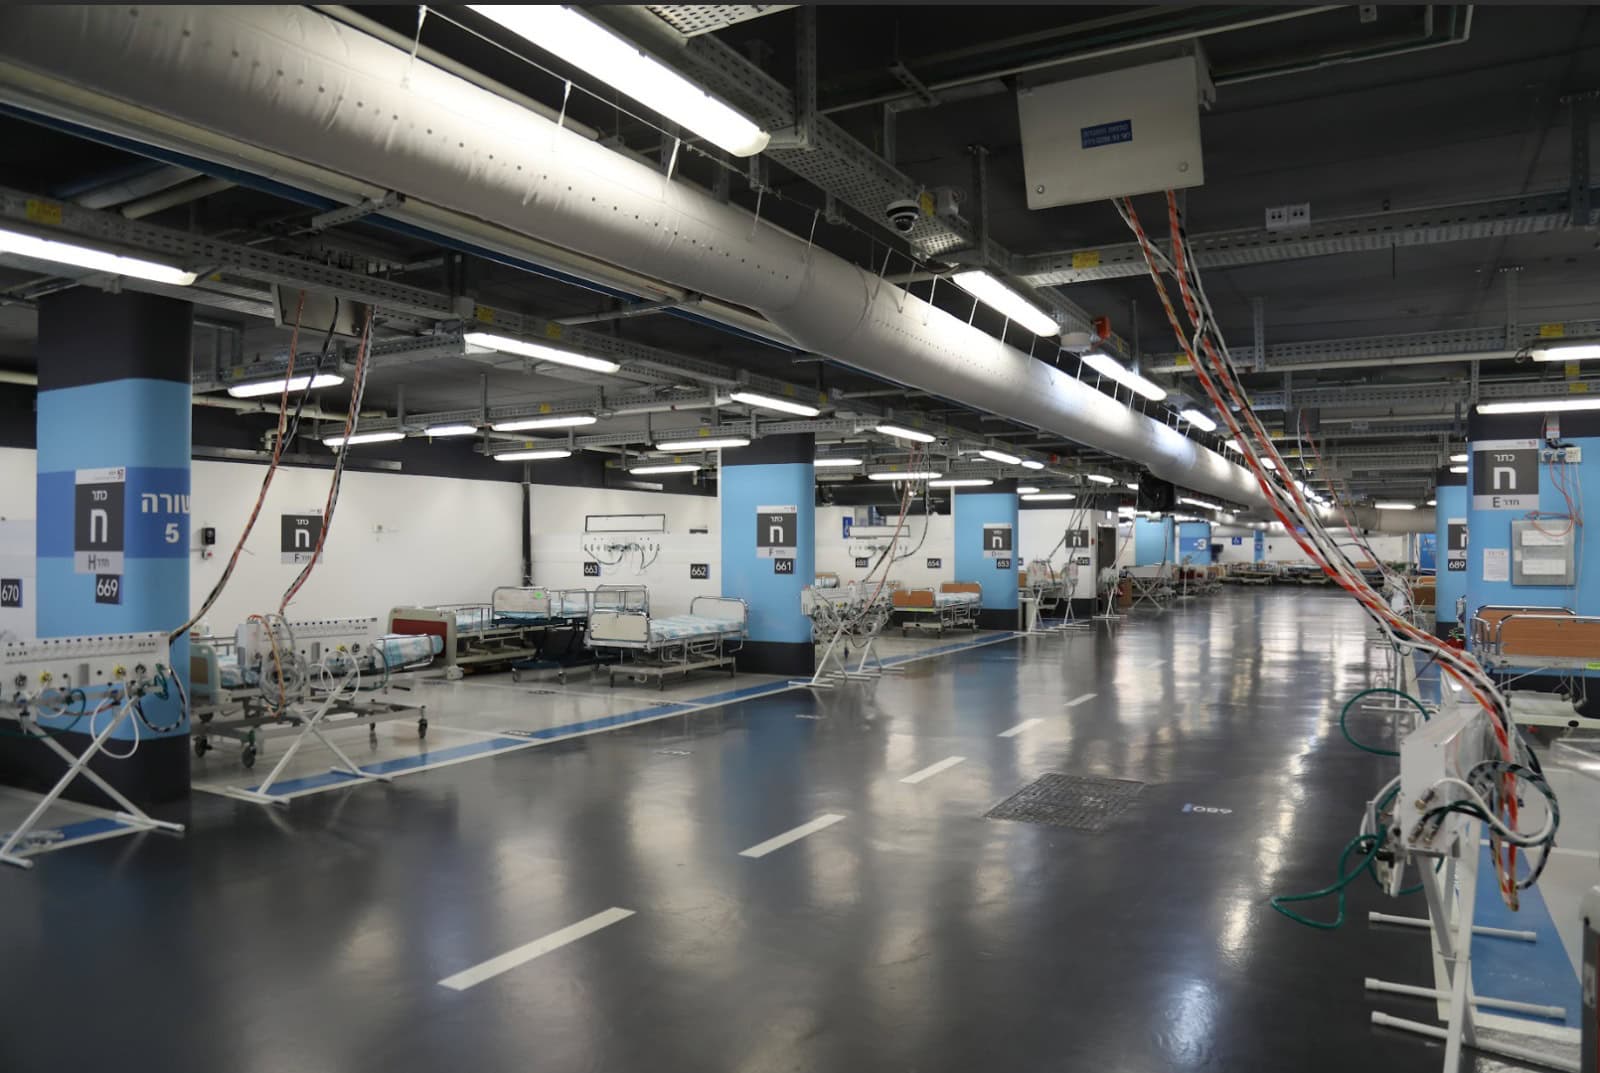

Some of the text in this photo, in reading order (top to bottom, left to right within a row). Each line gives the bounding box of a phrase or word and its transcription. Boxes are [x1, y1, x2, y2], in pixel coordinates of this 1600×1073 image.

[1493, 453, 1516, 462] כתר
[1493, 466, 1517, 490] ח
[91, 489, 108, 501] כתר
[1492, 496, 1501, 508] E
[90, 508, 108, 543] ח
[165, 522, 180, 543] 5
[295, 528, 310, 548] ח
[769, 525, 784, 544] ח
[992, 536, 1003, 549] ח
[1193, 538, 1207, 551] -3
[88, 553, 96, 570] H
[775, 561, 792, 571] 661
[927, 560, 940, 568] 654
[997, 559, 1010, 568] 653
[1448, 560, 1465, 569] 689
[584, 565, 598, 574] 663
[691, 567, 706, 576] 662
[1, 584, 19, 602] 670
[96, 577, 118, 598] 669
